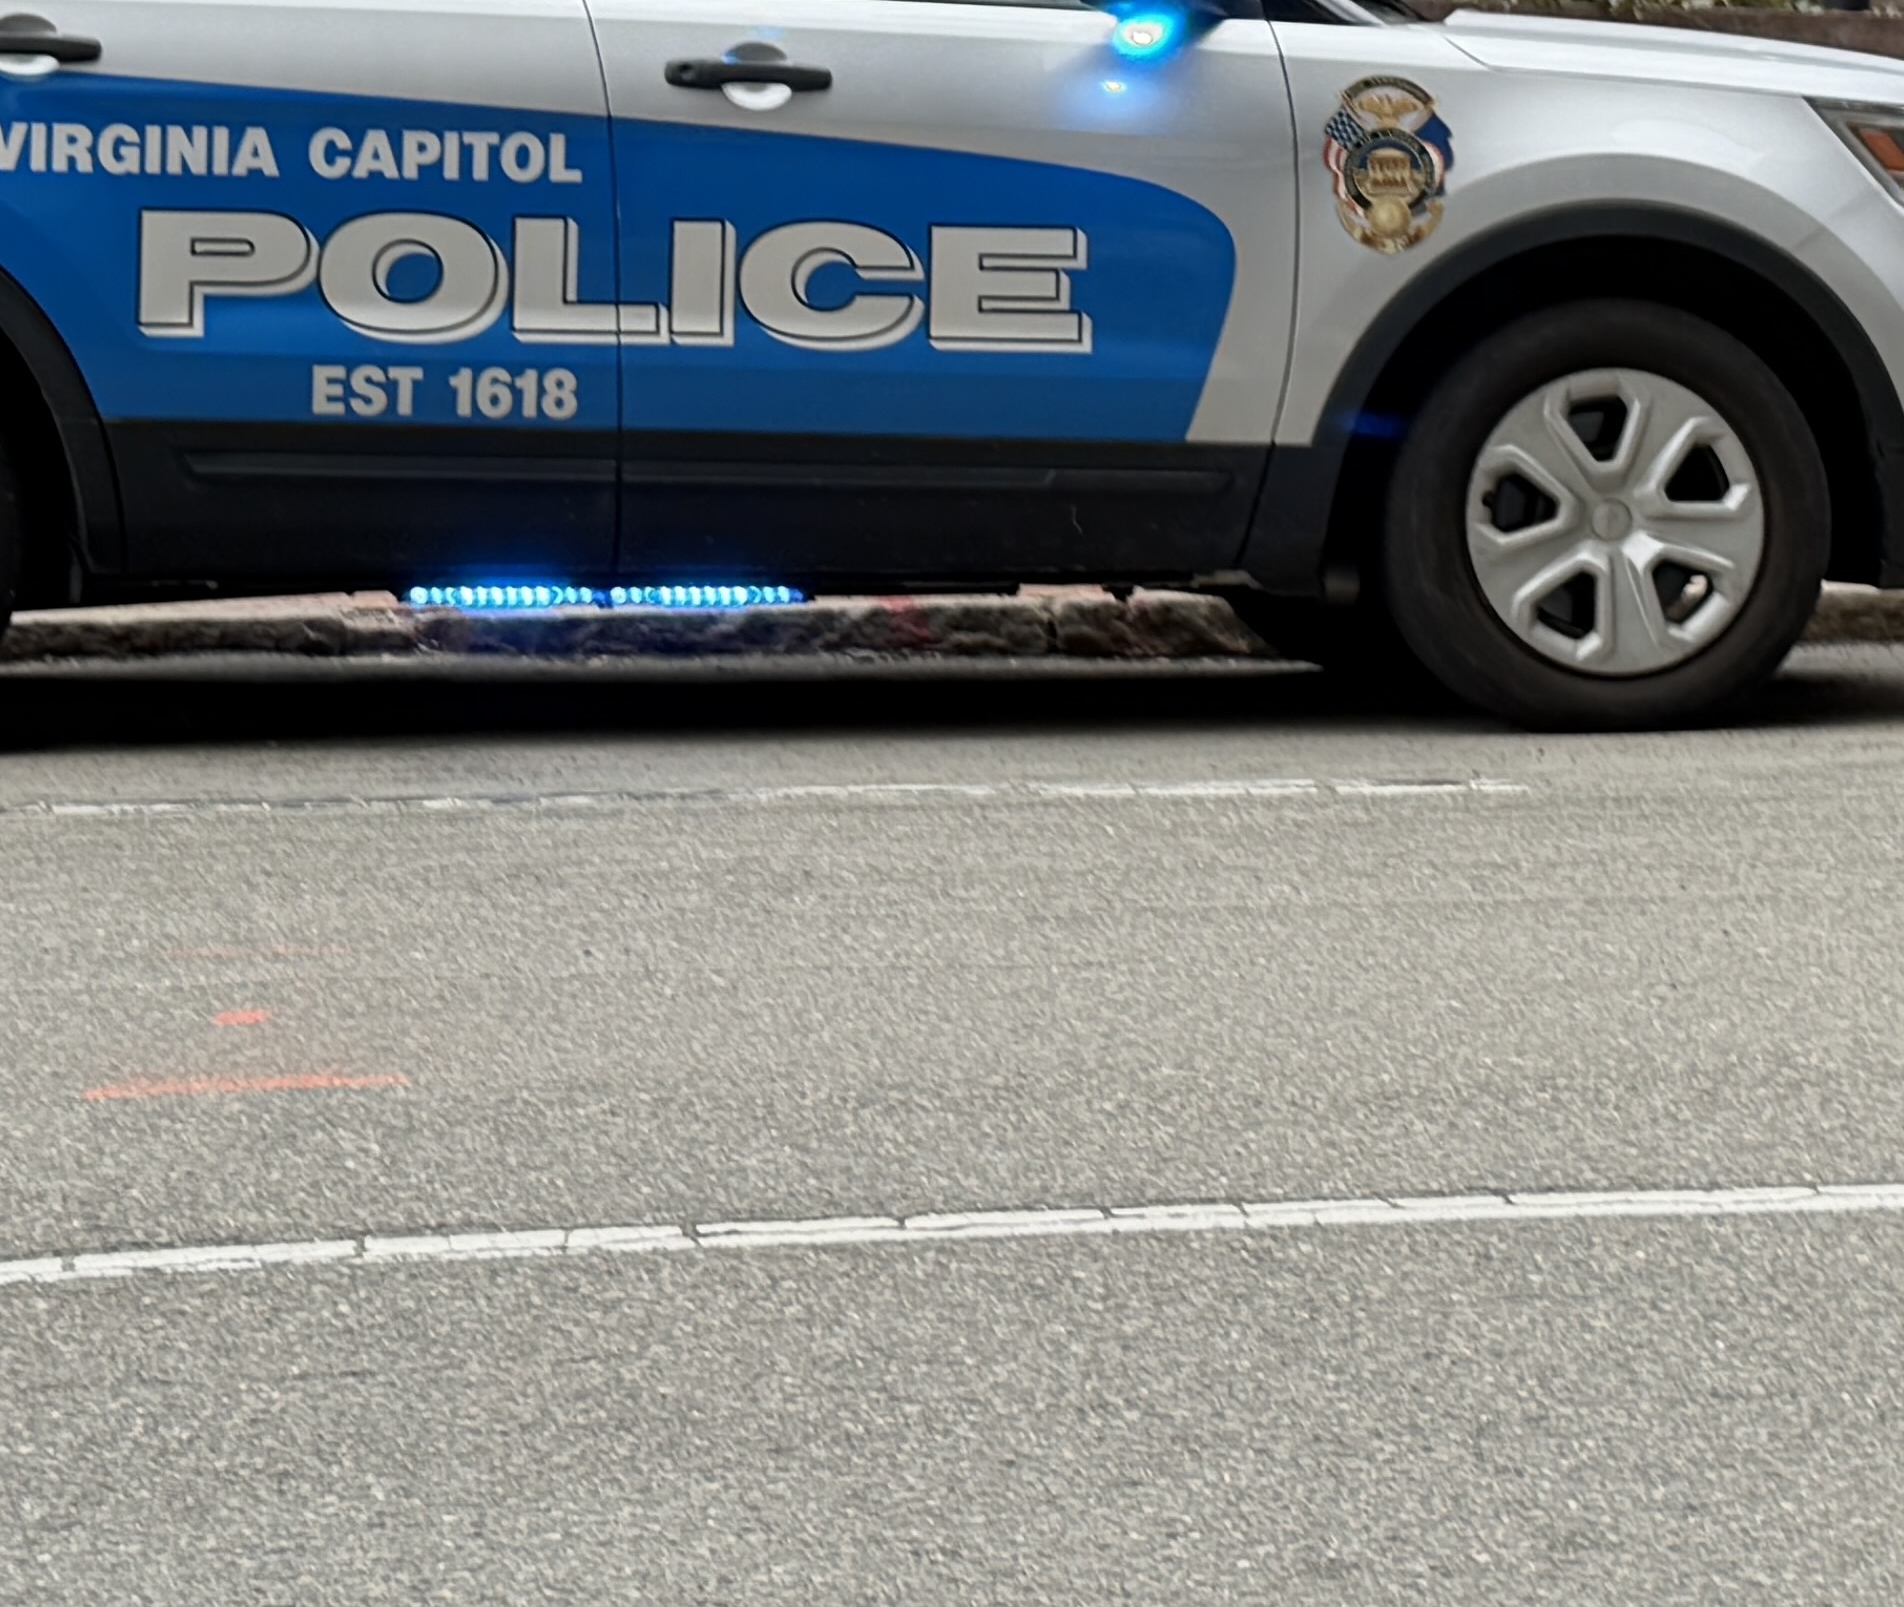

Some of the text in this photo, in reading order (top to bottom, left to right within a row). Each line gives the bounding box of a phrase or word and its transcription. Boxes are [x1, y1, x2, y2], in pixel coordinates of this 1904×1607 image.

[307, 126, 584, 186] CAPITOL
[136, 207, 1093, 353] POLICE
[310, 364, 580, 421] EST 1618
